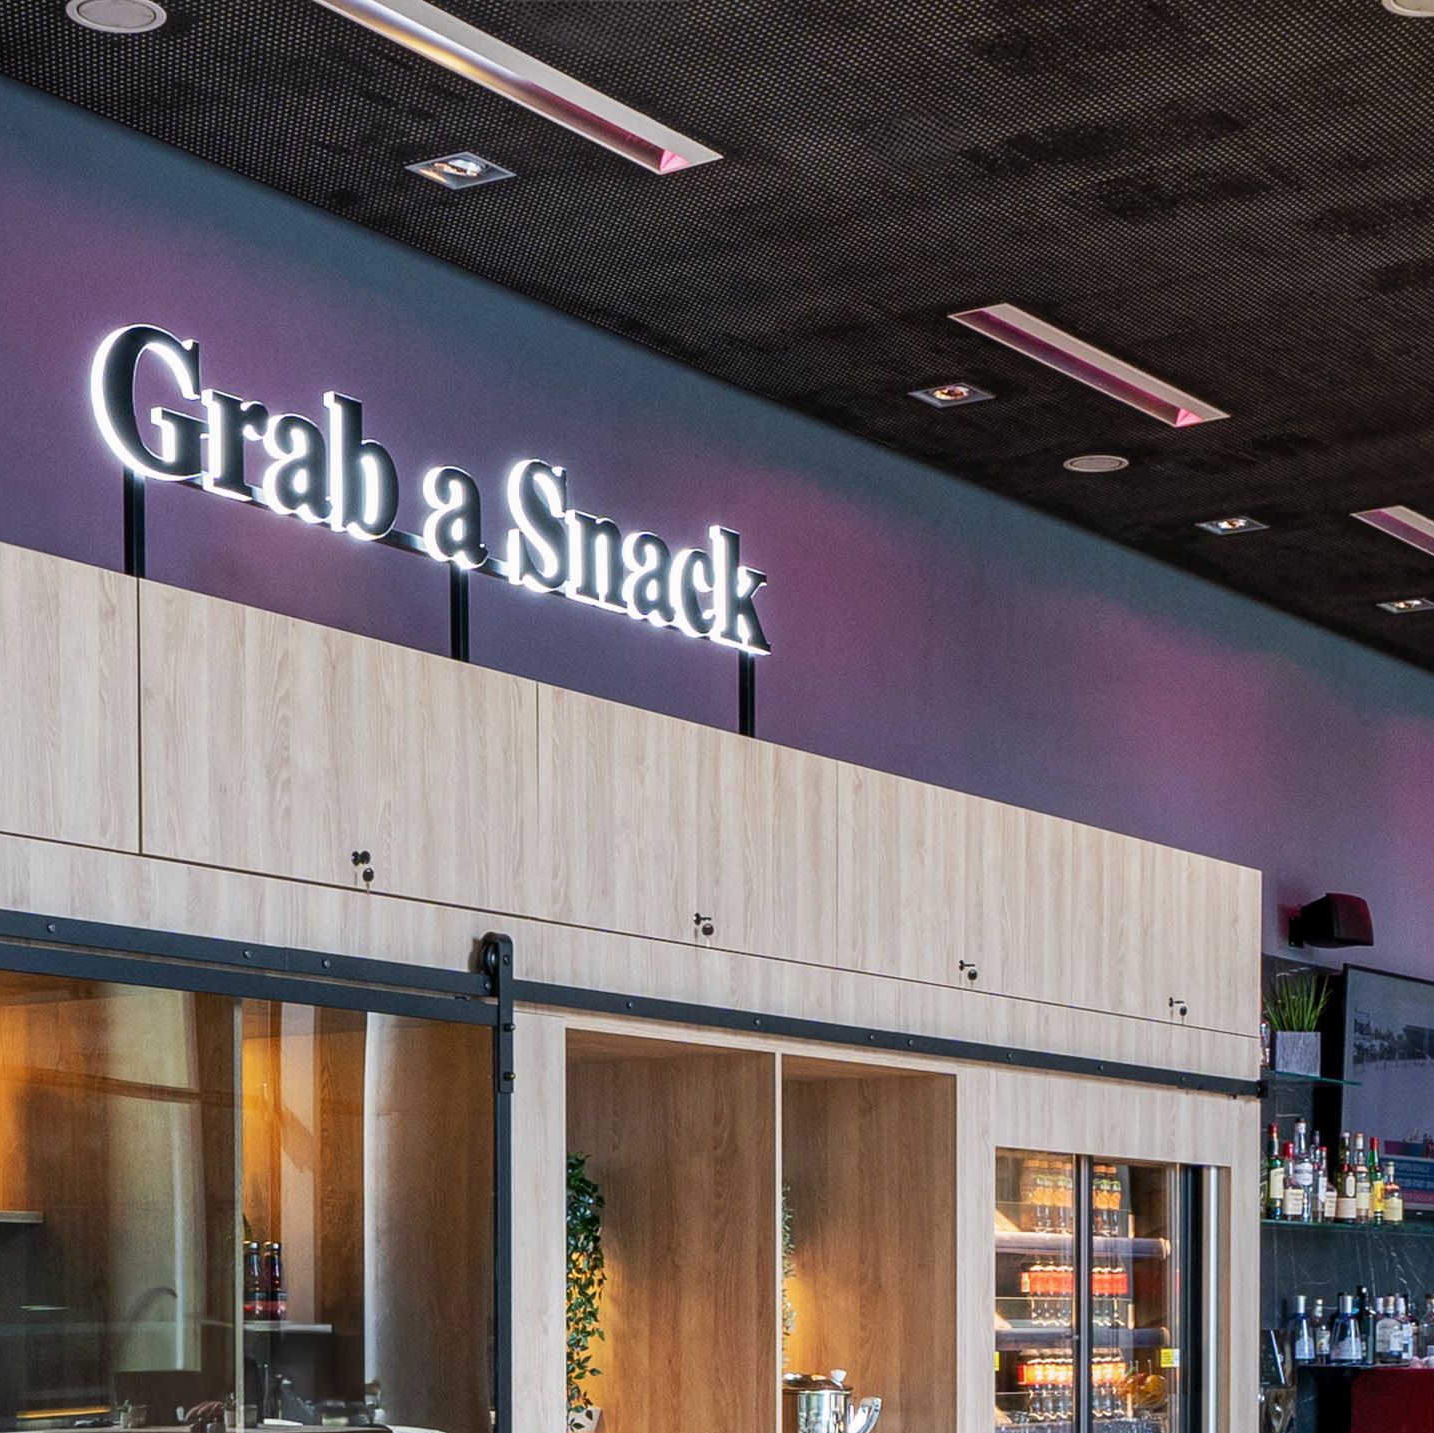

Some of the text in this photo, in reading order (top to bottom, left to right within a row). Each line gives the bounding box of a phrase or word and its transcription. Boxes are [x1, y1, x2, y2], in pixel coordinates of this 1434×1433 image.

[90, 323, 772, 657] Grab a Snack
